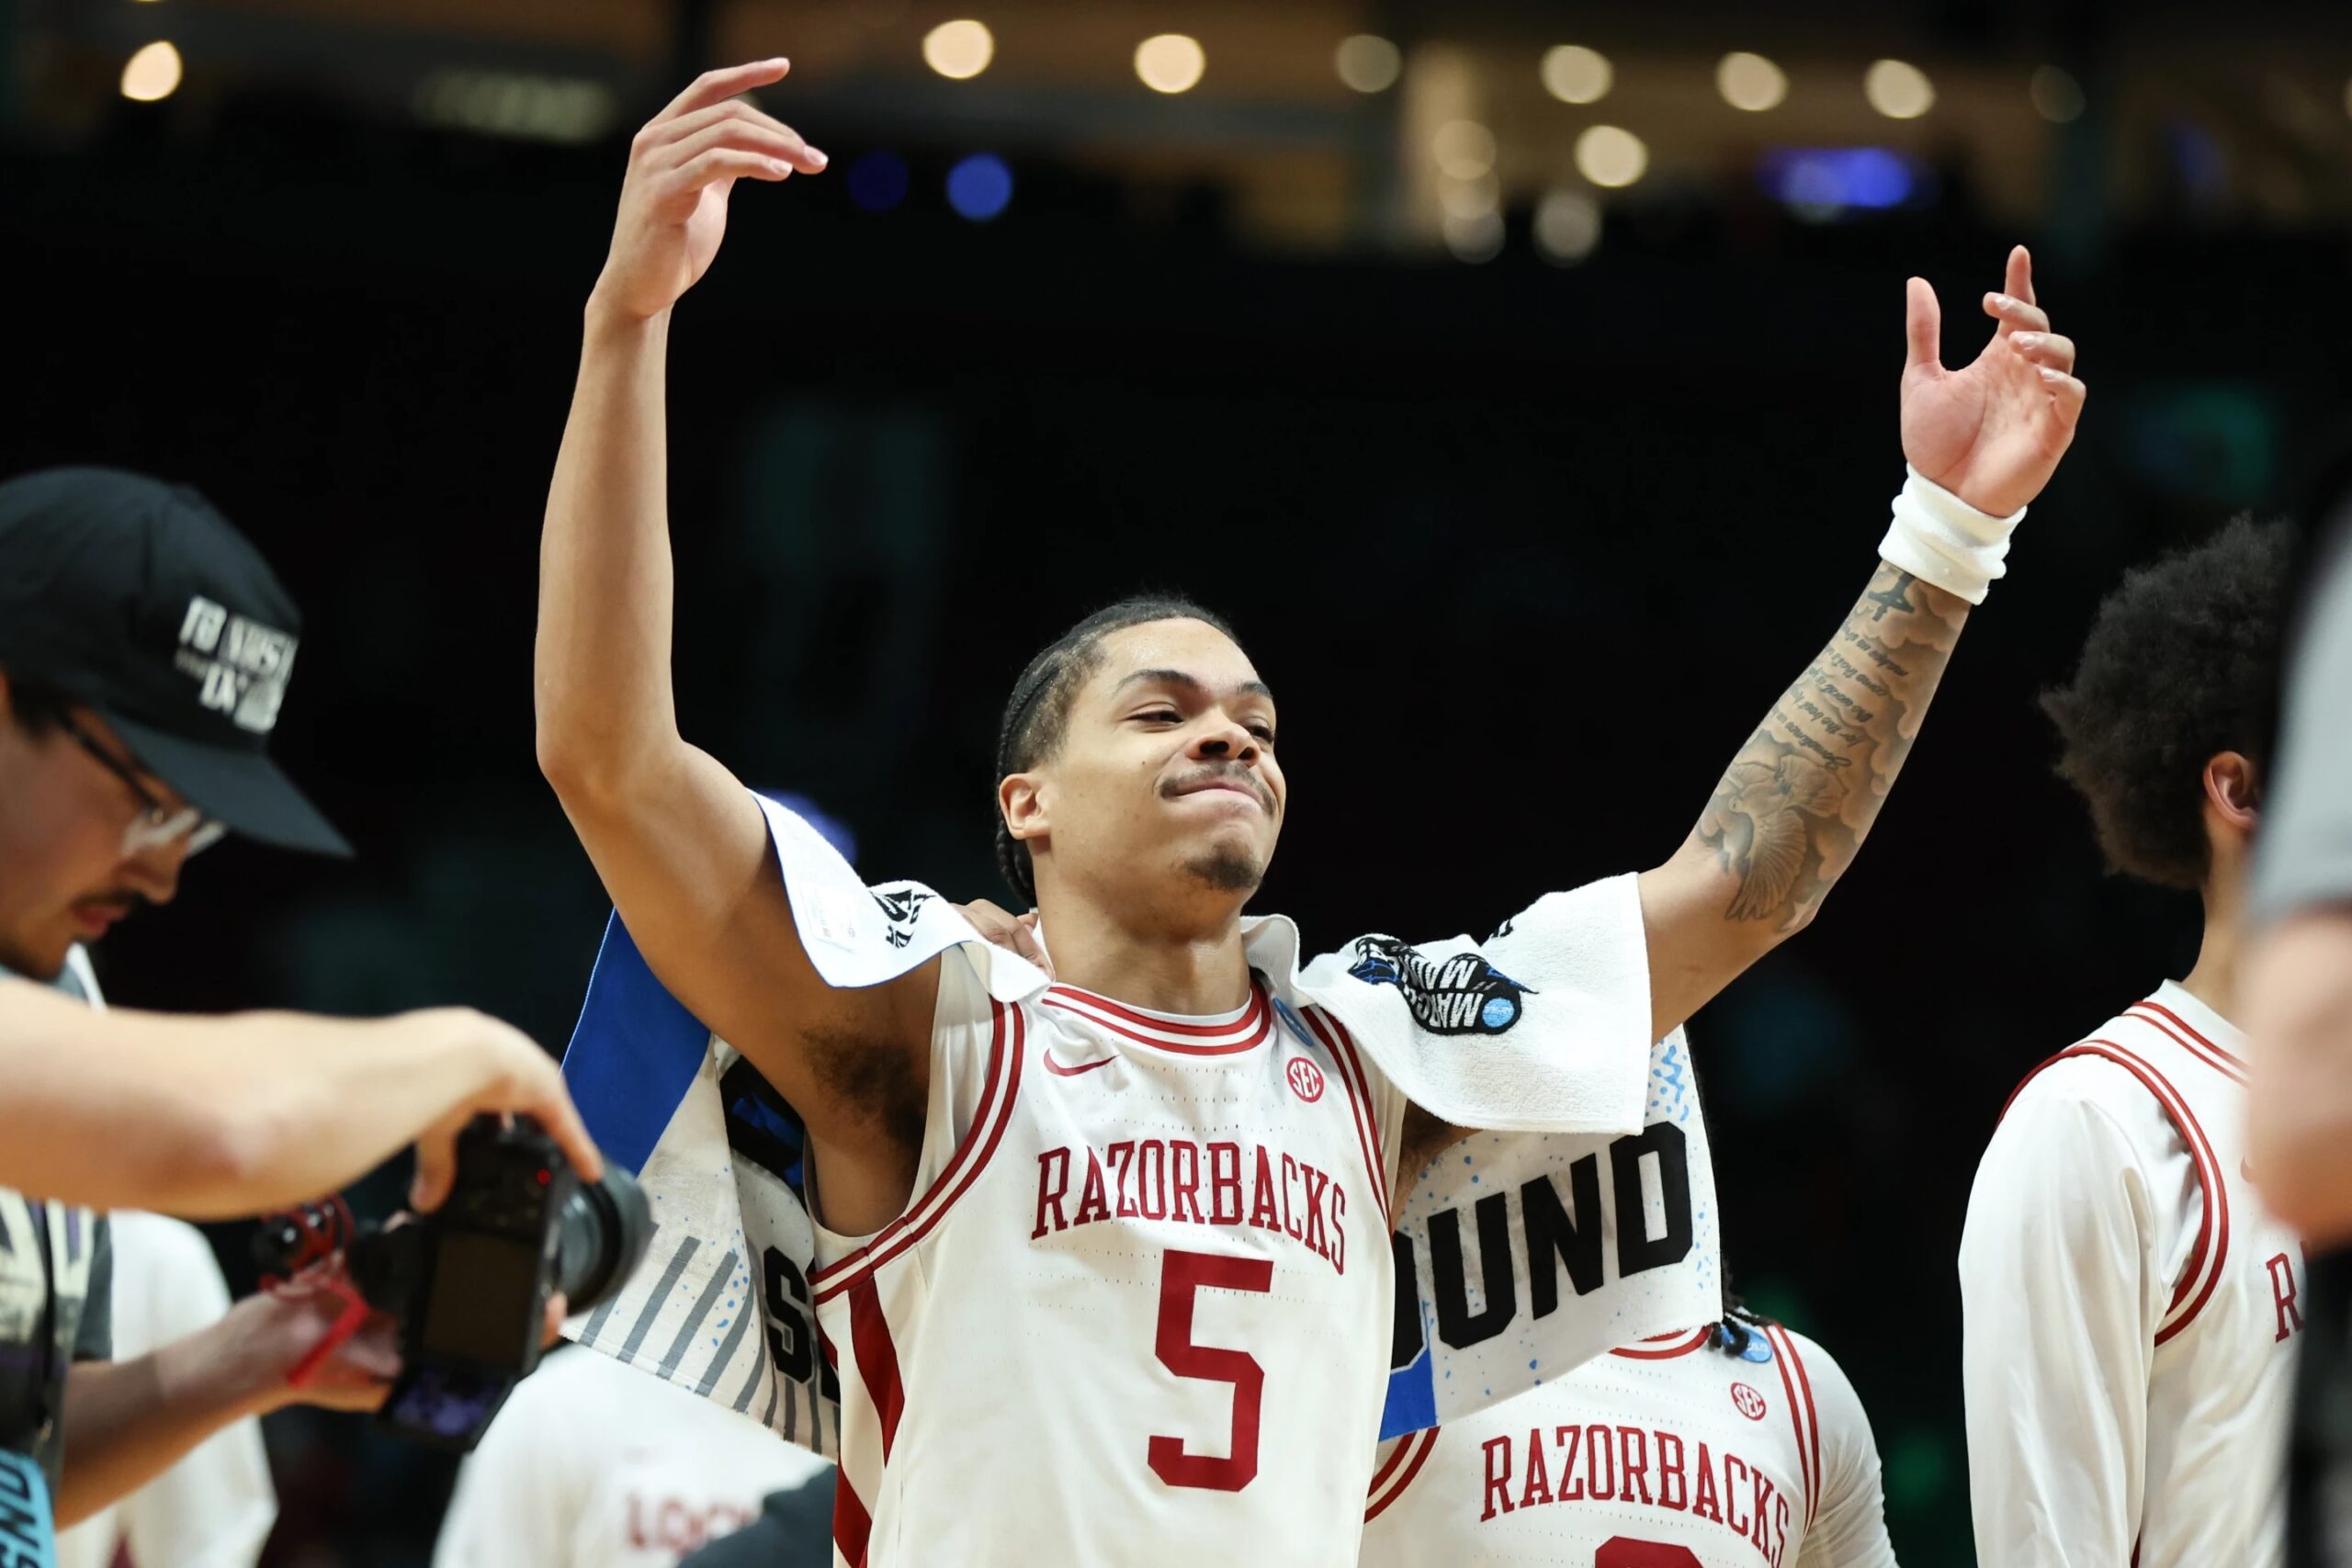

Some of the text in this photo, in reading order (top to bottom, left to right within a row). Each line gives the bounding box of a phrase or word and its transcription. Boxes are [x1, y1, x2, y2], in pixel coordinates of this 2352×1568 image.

[1288, 1058, 1323, 1100] SEC
[1031, 1139, 1345, 1276] RAZORBACKS
[1148, 1248, 1274, 1492] 5
[1731, 1383, 1766, 1420] SEC
[1480, 1424, 1789, 1568] RAZORBACKS
